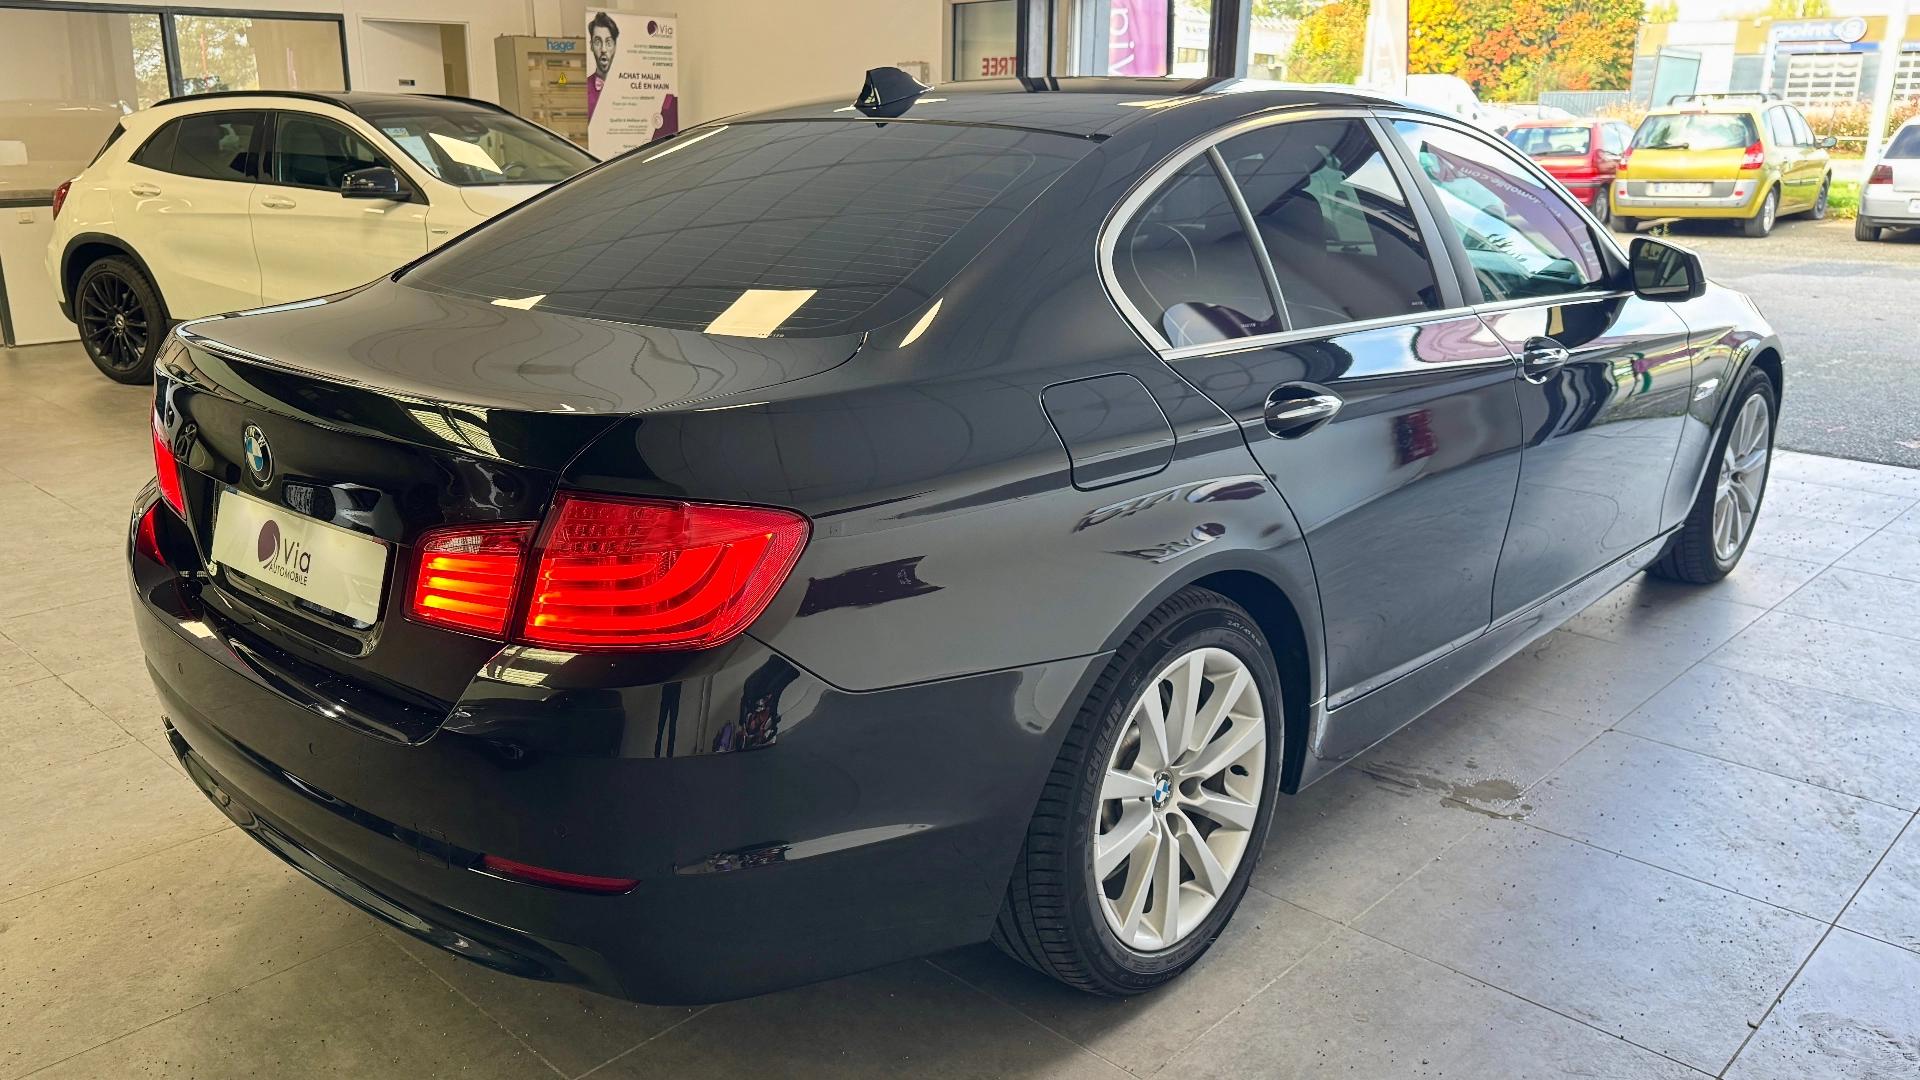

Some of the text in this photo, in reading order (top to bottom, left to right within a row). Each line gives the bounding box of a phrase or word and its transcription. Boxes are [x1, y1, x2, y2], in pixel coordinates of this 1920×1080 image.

[659, 25, 673, 35] Via
[547, 38, 576, 52] hager
[618, 72, 640, 80] ACHAT
[630, 82, 642, 90] CLÉ
[284, 538, 311, 574] Via
[269, 563, 308, 585] AUTOMOBILE
